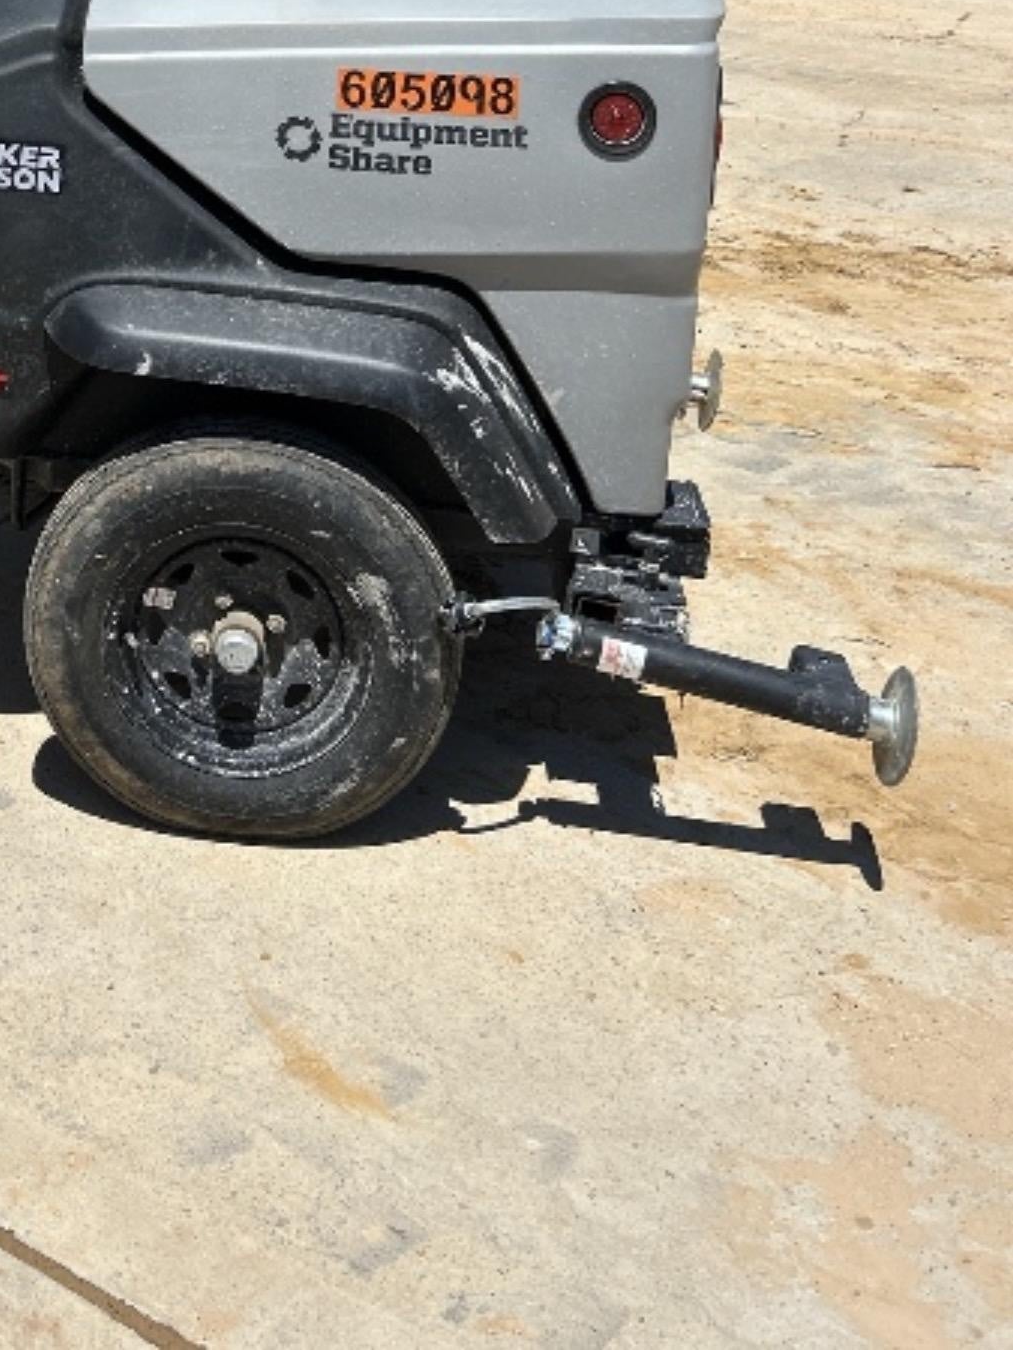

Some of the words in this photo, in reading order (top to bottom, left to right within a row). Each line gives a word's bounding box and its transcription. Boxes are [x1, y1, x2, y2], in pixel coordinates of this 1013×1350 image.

[340, 69, 517, 115] 605098
[329, 114, 529, 150] Equipment
[328, 146, 432, 175] Share
